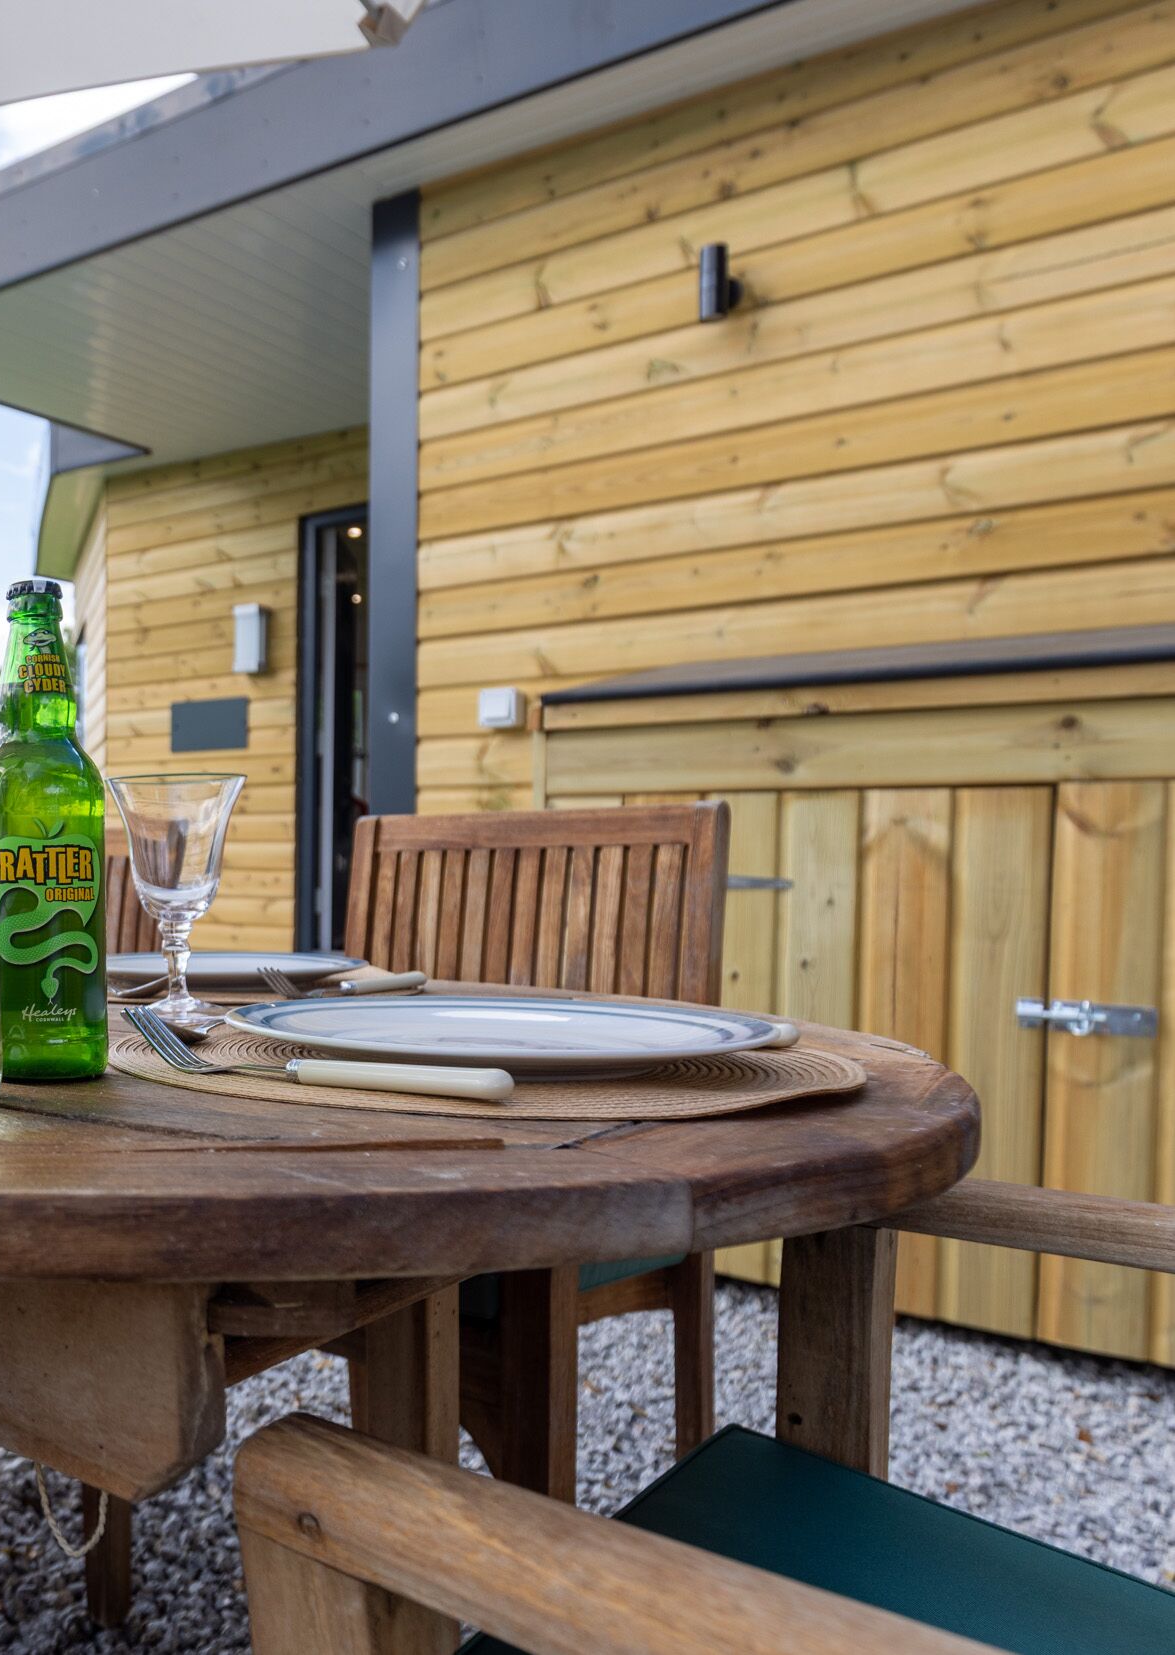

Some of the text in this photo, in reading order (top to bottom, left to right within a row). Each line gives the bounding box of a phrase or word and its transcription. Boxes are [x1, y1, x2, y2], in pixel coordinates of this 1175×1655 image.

[26, 654, 61, 664] CORNISH
[18, 662, 66, 679] CLOUDY
[24, 677, 66, 693] CYDER
[44, 886, 94, 902] ORIGINAL
[22, 1003, 77, 1022] Healeys
